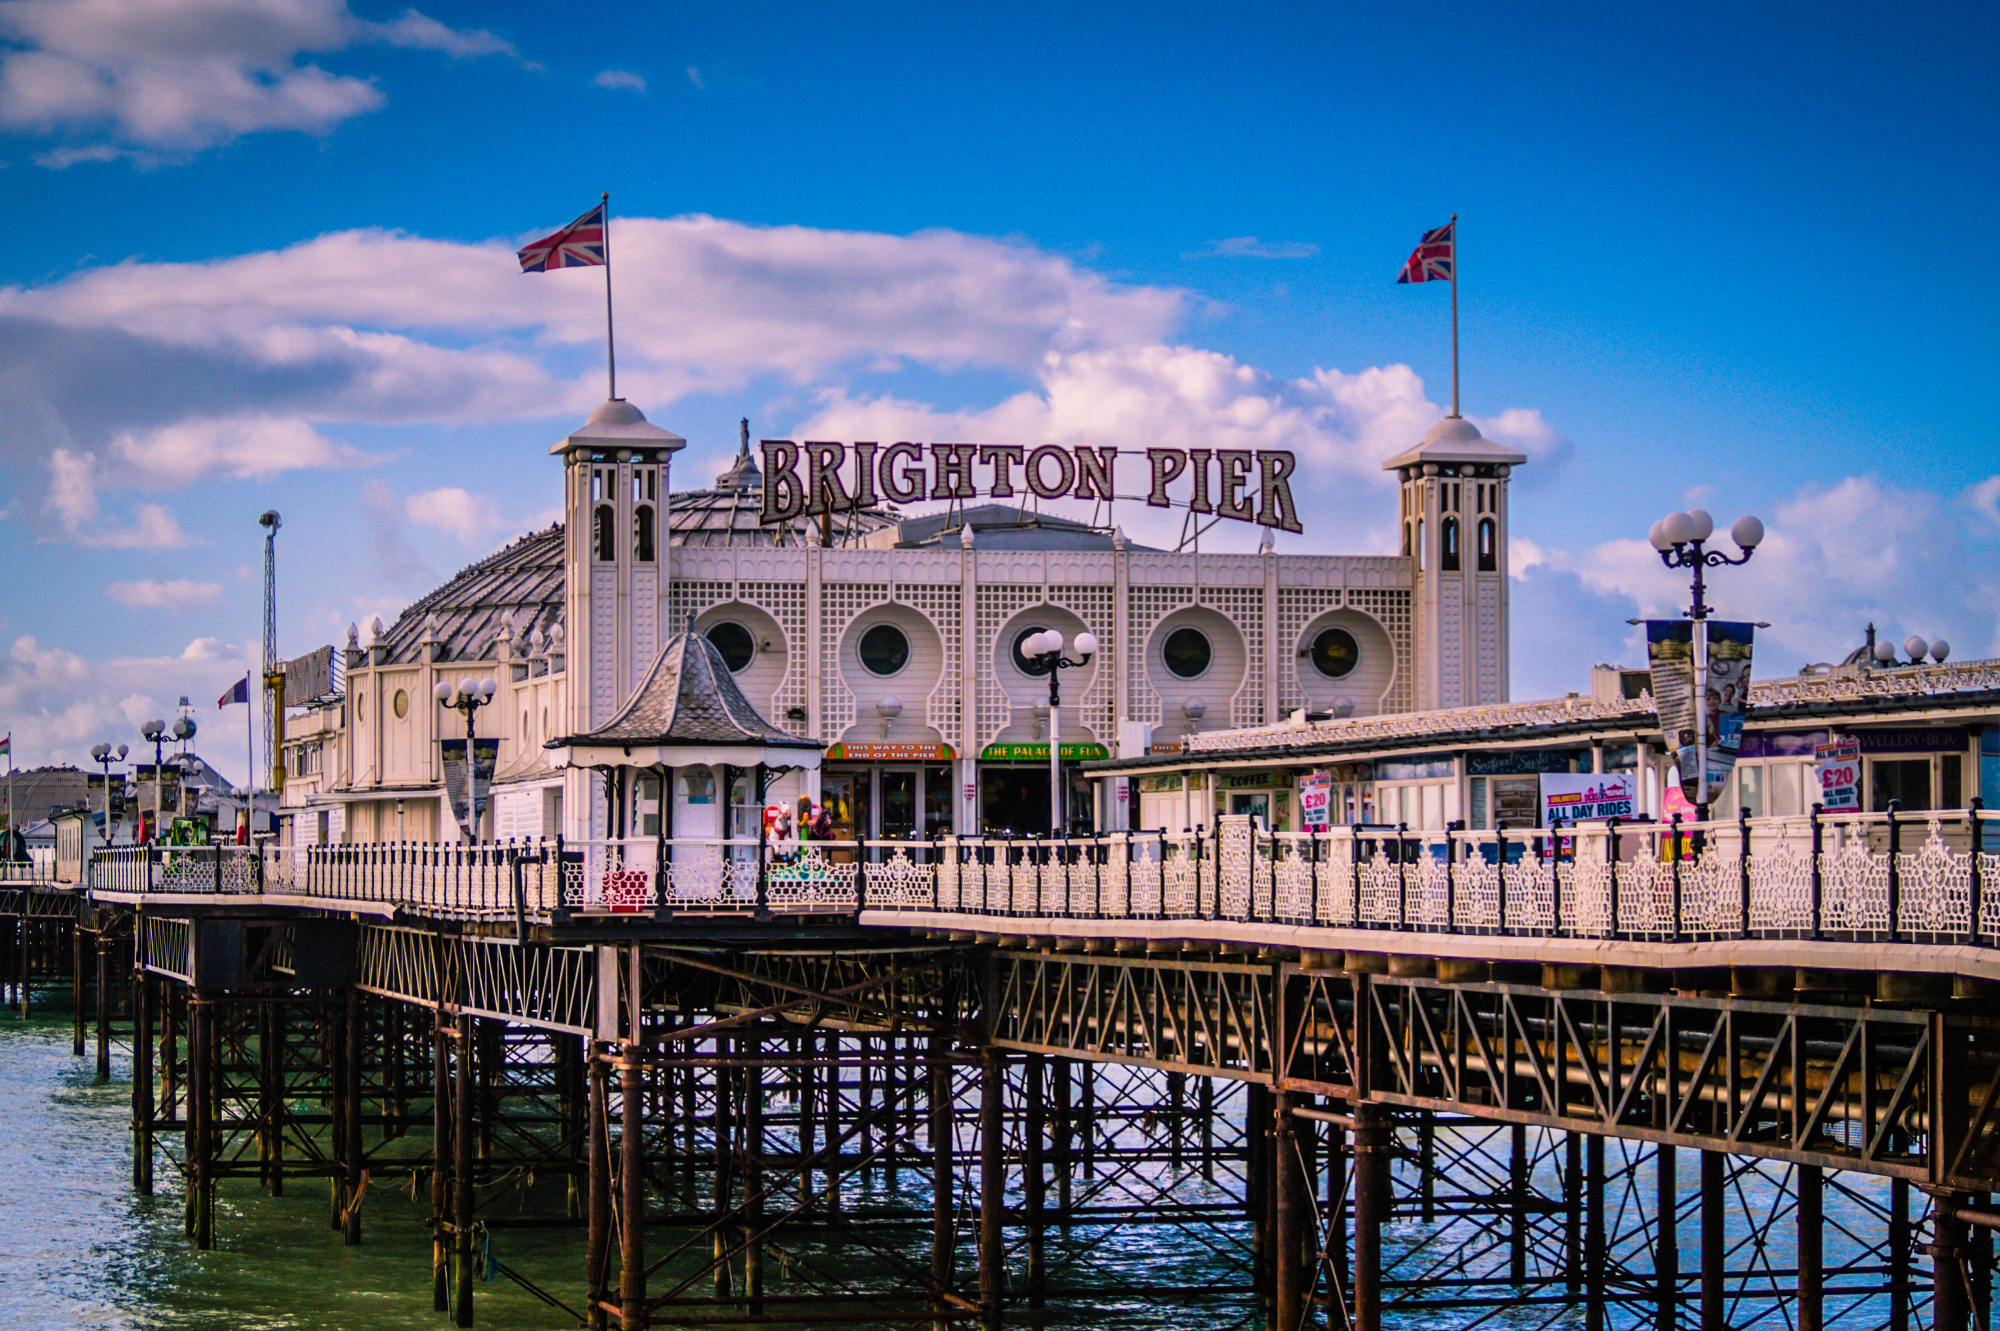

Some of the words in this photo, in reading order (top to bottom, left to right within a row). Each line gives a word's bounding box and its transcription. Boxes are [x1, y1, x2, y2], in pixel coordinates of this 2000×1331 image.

[759, 439, 1119, 526] BRIGHTON
[1146, 447, 1303, 535] PIER
[988, 747, 1008, 757] THE
[1014, 747, 1052, 757] PALAC
[1060, 747, 1074, 757] OF
[1080, 747, 1102, 757] FUN
[1230, 773, 1269, 787] COFFEE
[1822, 766, 1853, 788] £20
[1305, 792, 1326, 809] £20
[1550, 794, 1581, 803] UNLIMITED
[1824, 789, 1834, 798] ALL
[1828, 797, 1838, 805] ALL
[1839, 796, 1851, 804] DAY
[1547, 806, 1569, 822] ALL
[1572, 804, 1594, 819] DAY
[1597, 800, 1632, 817] RIDES
